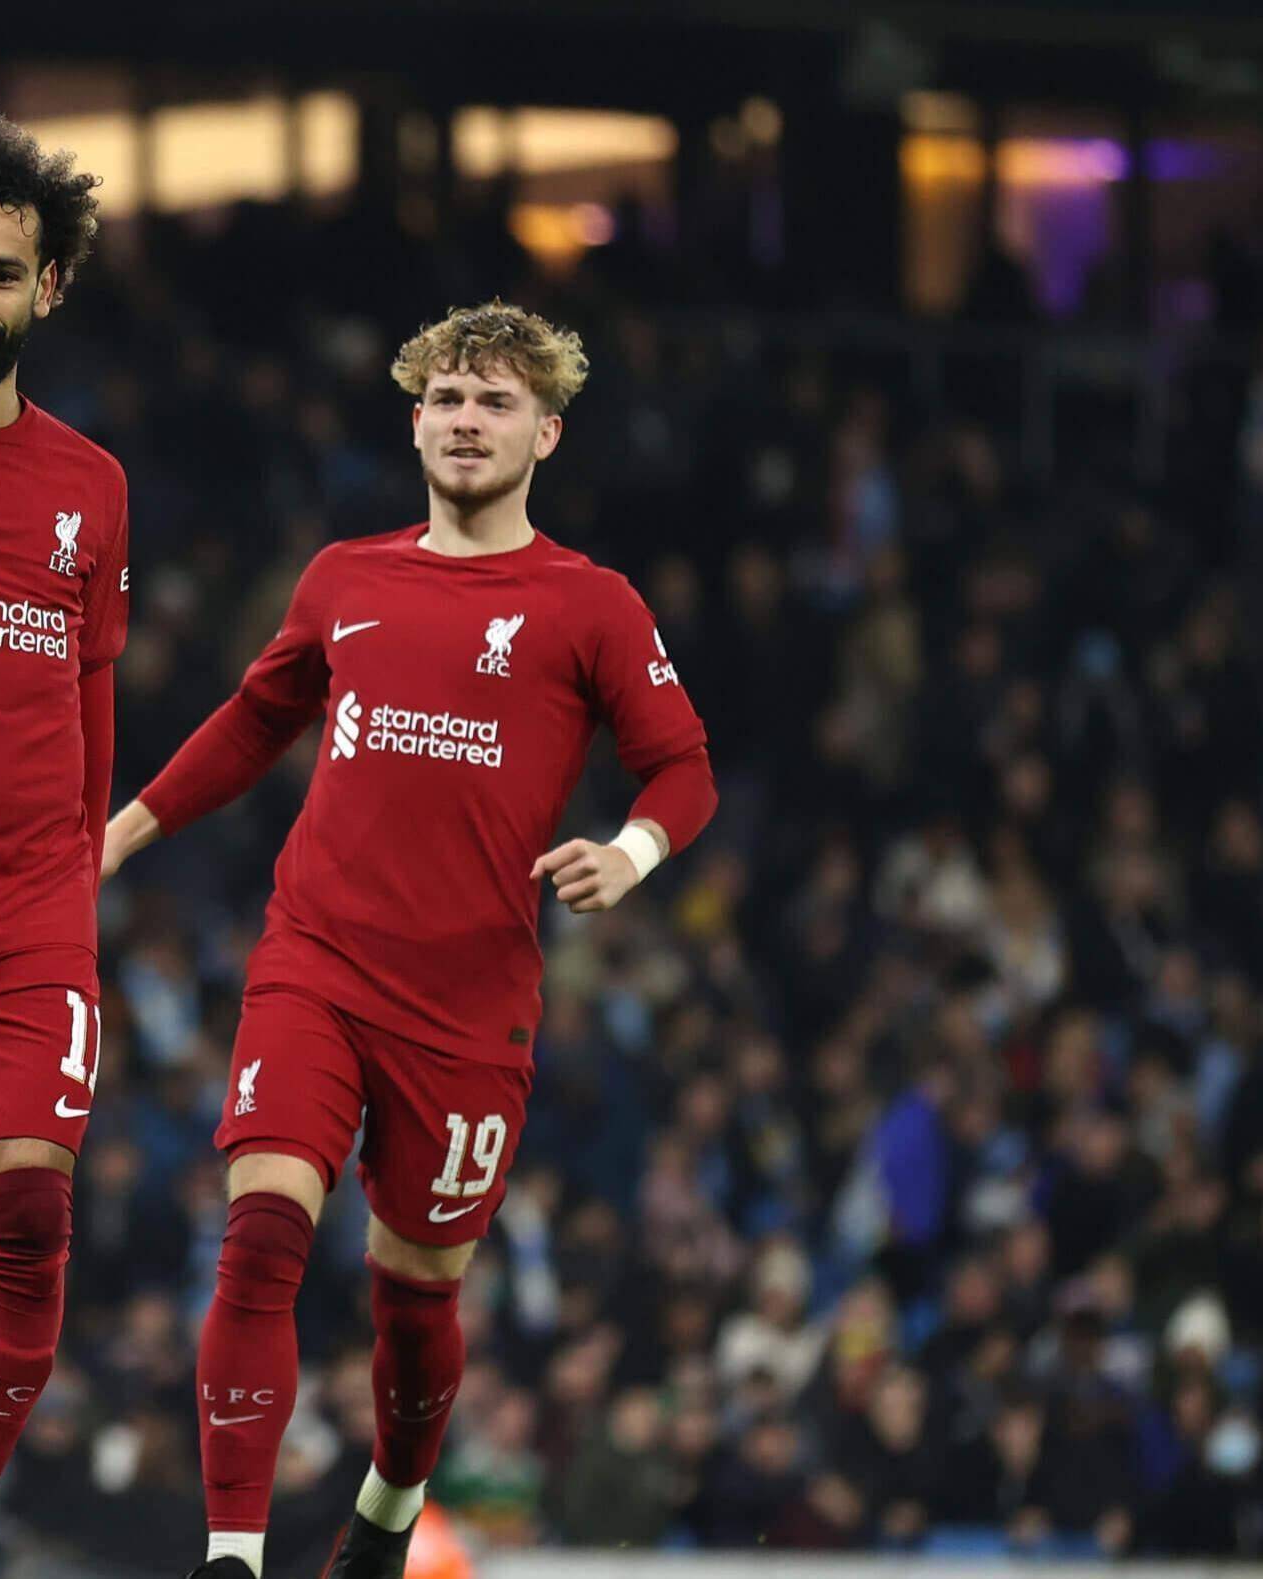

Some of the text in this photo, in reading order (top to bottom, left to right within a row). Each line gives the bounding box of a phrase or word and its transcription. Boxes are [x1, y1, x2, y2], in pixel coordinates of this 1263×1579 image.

[369, 703, 498, 745] standard
[366, 727, 503, 768] chartered
[431, 1113, 506, 1198] 19
